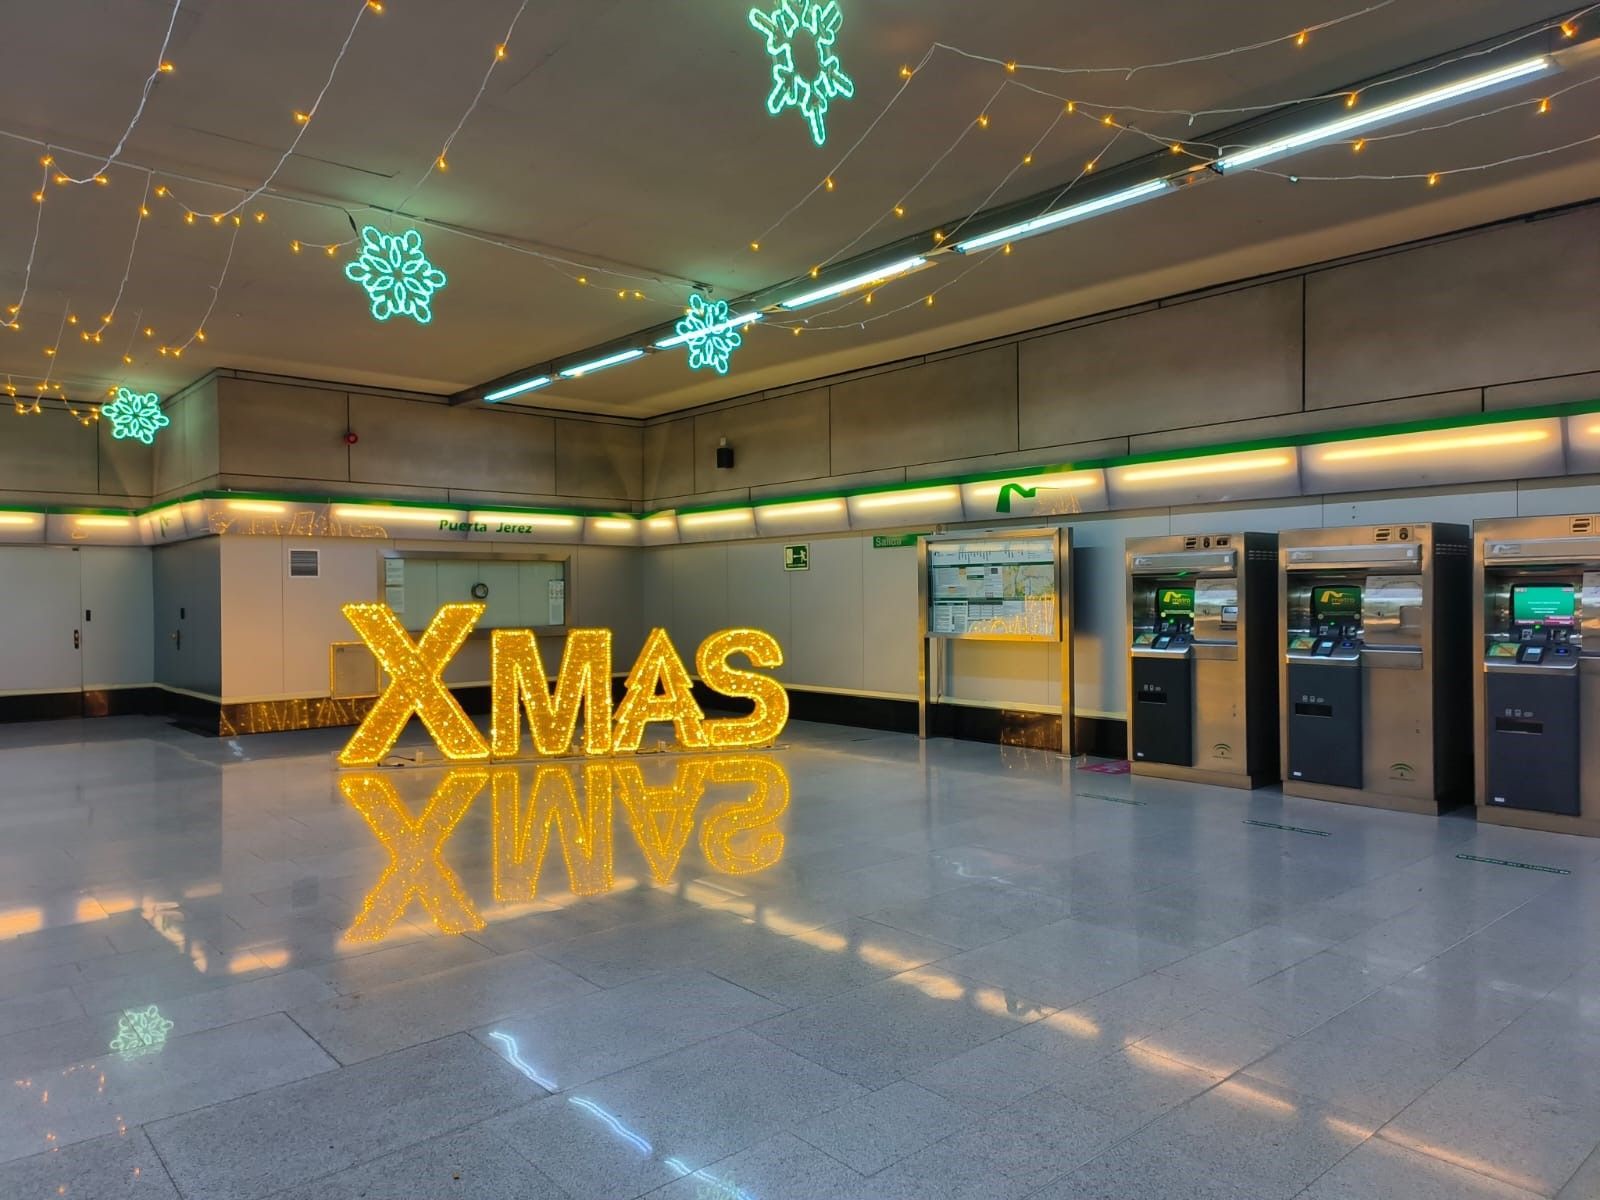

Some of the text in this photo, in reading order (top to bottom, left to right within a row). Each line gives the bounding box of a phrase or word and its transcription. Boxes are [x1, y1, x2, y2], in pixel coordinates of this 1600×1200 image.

[439, 519, 532, 534] Puerta Jerez
[336, 602, 791, 766] XMAS
